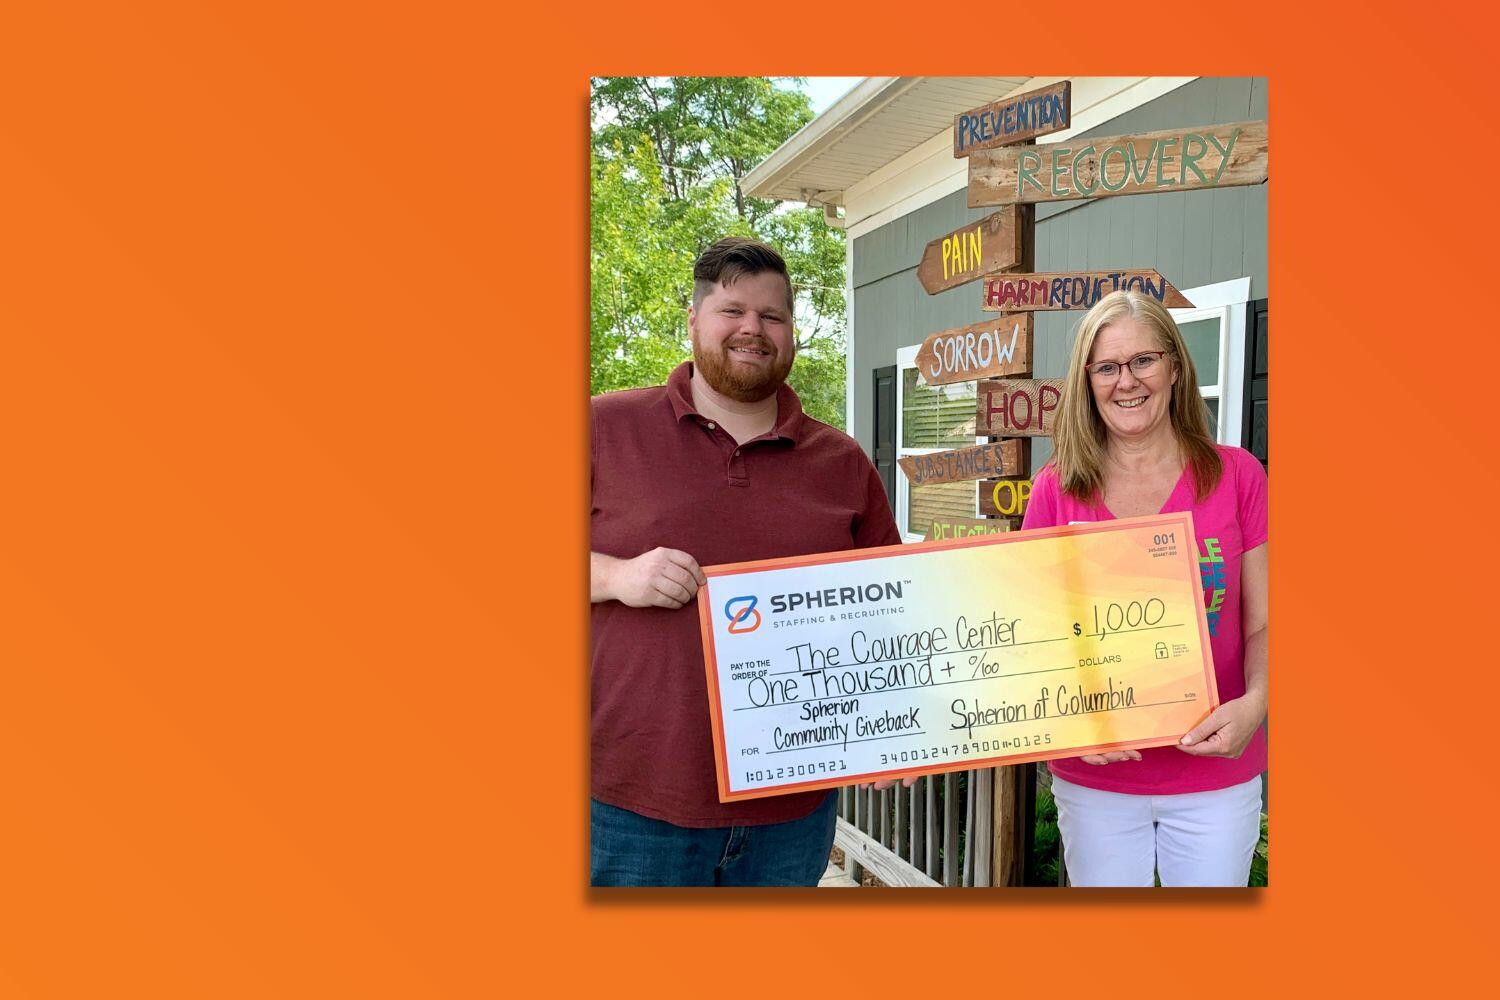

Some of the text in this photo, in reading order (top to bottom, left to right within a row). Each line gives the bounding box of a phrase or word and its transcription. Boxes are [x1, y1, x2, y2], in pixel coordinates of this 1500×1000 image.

[958, 88, 1069, 151] PREVENTION
[1016, 127, 1242, 198] RECOVERY
[942, 226, 983, 280] PAIN
[987, 278, 1049, 307] HARM
[930, 322, 1020, 378] SORROW
[986, 384, 1061, 431] HOP
[914, 444, 1004, 483] SUBSTANCES
[993, 480, 1034, 515] OP
[1153, 532, 1176, 545] 001
[773, 606, 905, 629] STAFFING & RECRUITING
[1073, 622, 1082, 636] $
[1093, 598, 1165, 641] 1,000
[786, 611, 1021, 672] The Courage Center
[1079, 654, 1122, 667] DOLLARS
[730, 659, 771, 671] PAY TO THE
[731, 669, 768, 681] ORDER OF
[748, 676, 800, 707] One
[802, 655, 934, 698] Thousand
[940, 662, 955, 677] +
[800, 698, 859, 722] Spherion
[950, 677, 1137, 739] Spherion of Columbia
[774, 707, 921, 752] Community Giveback
[741, 747, 760, 757] FOR
